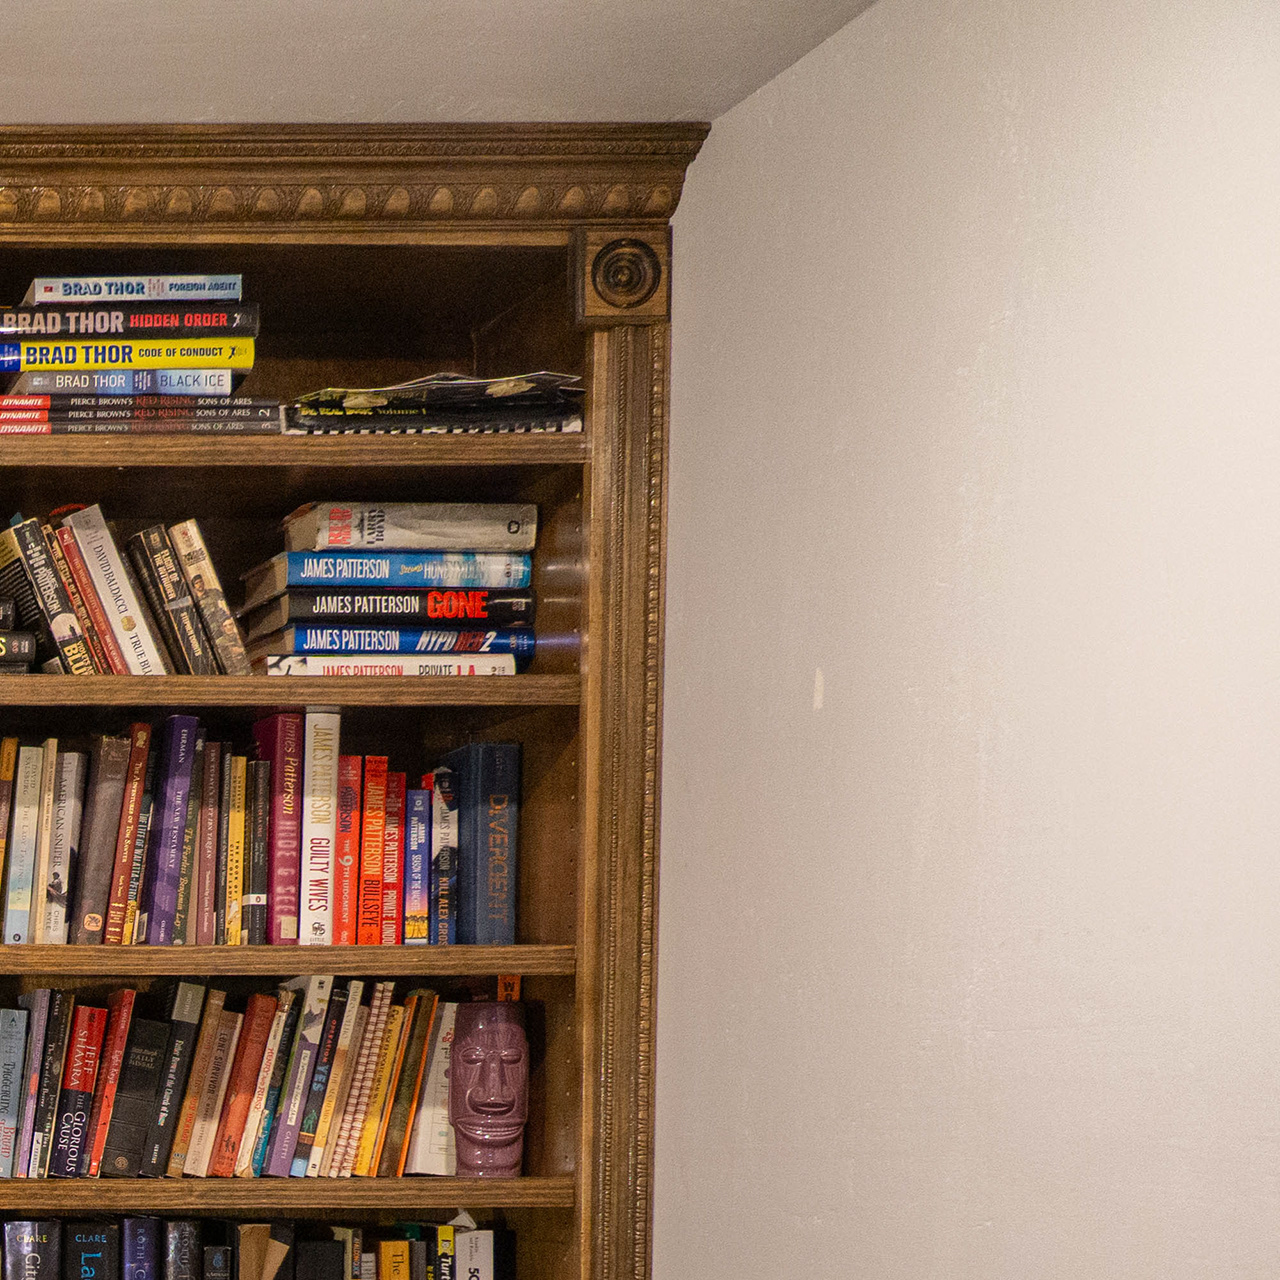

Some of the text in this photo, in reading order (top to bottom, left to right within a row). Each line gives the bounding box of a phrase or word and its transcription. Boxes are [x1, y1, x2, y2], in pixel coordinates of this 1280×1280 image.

[65, 312, 124, 333] THOR
[130, 314, 179, 328] HIDDEN
[184, 313, 228, 327] ORDER
[93, 545, 146, 659] DAVID BALDACCI TRUE
[312, 591, 488, 619] JAMES PATTERSON GONE
[51, 778, 70, 868] AMERICAN SNIPER
[308, 724, 333, 912] JAMES PATTERSON GUILTY WIVES
[362, 783, 381, 927] JAMES PATTERSON BULLSEYE
[69, 1029, 88, 1087] SHAARA
[83, 1045, 96, 1074] JEFF
[57, 1112, 73, 1150] CAUSE
[66, 1111, 86, 1172] GLORIOUS
[392, 1252, 404, 1276] The
